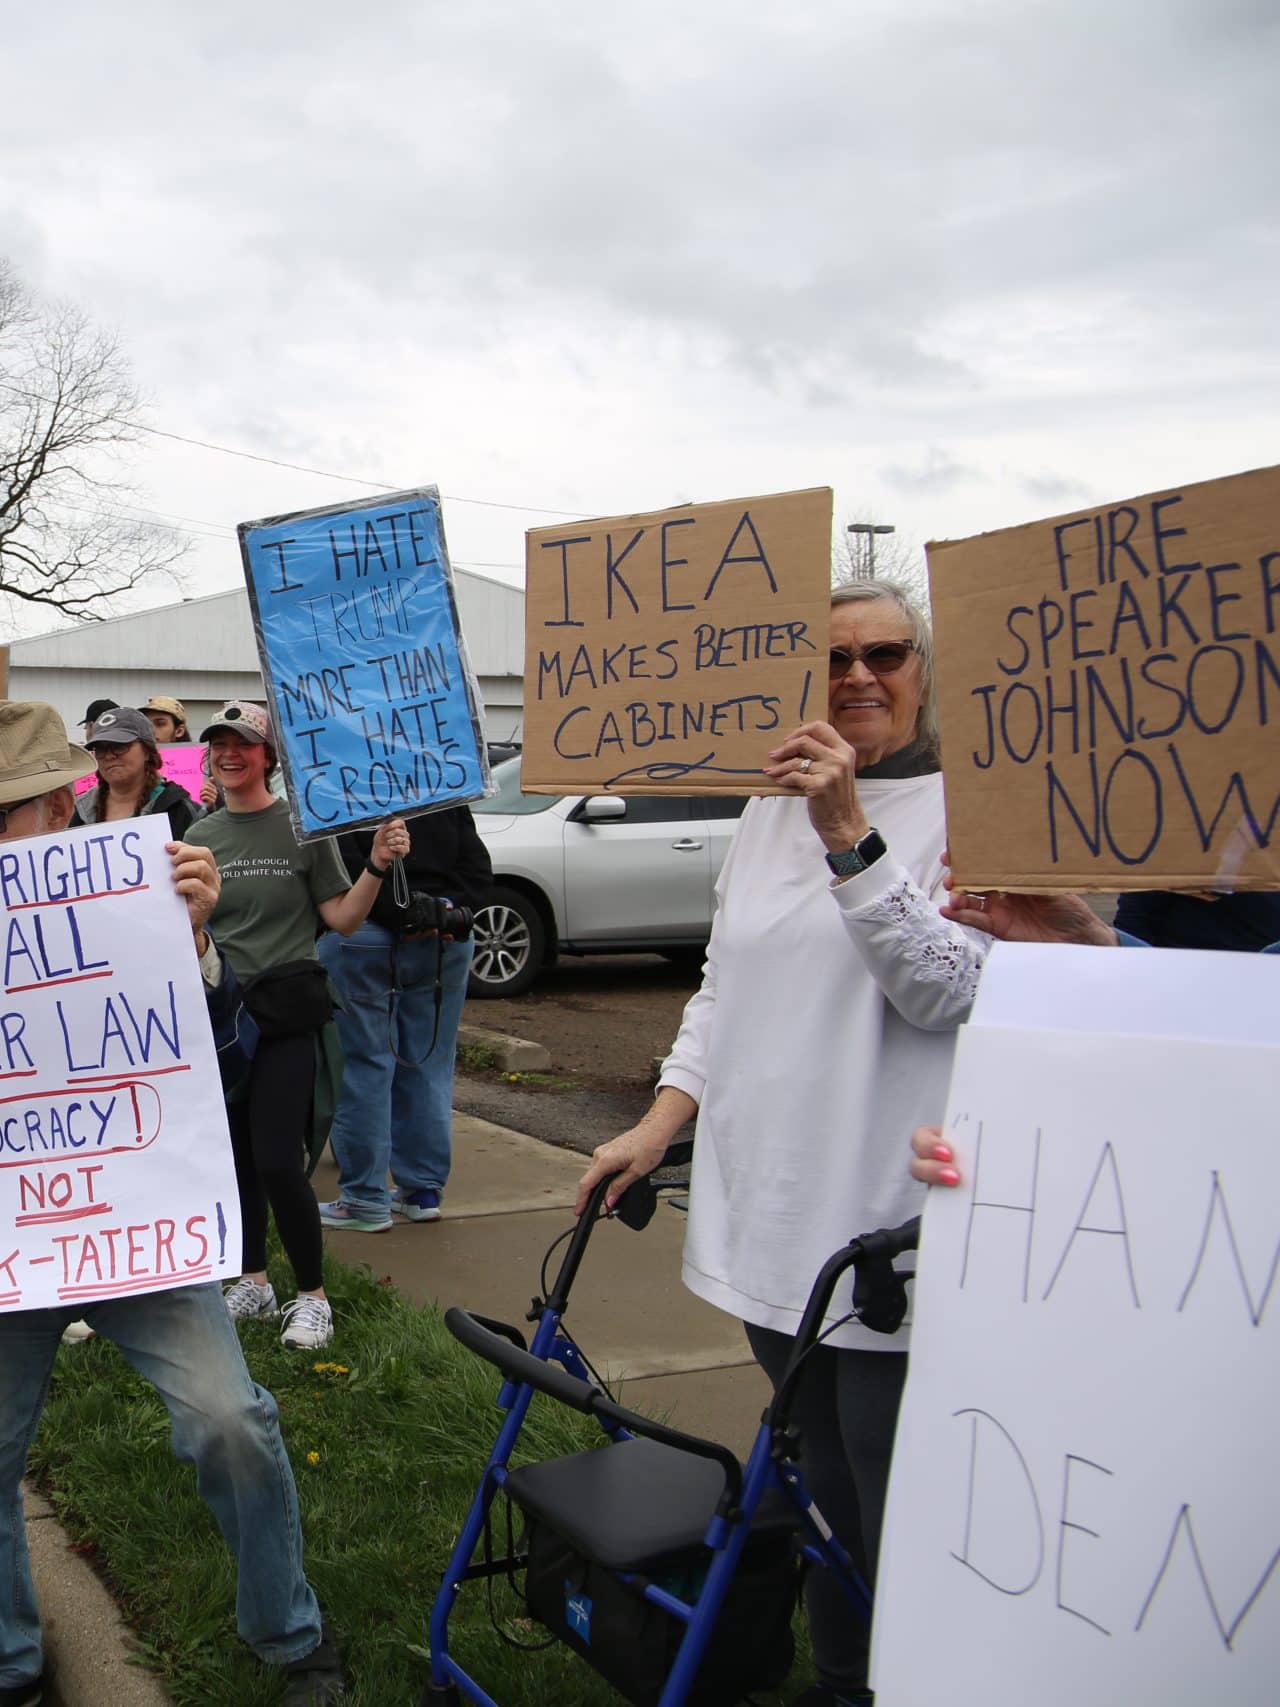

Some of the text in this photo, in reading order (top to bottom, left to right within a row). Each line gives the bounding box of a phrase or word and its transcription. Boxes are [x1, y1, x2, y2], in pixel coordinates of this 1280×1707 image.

[260, 508, 440, 594] I HATE
[541, 511, 778, 627] IKEA
[1054, 495, 1202, 591] FIRE
[292, 576, 419, 652] TRUMP
[280, 642, 452, 727] MORE THAN
[537, 621, 817, 700] MAKES BETTER
[296, 697, 455, 771] I HATE
[304, 743, 468, 823] CROWDS
[1045, 743, 1280, 865] NOW
[0, 831, 145, 908] RIGHTS
[222, 868, 296, 879] OLD WHITE MEN.
[252, 857, 289, 867] ENOUGH
[4, 906, 110, 986] ALL
[56, 981, 182, 1072] LAW
[19, 1164, 104, 1211] NOT
